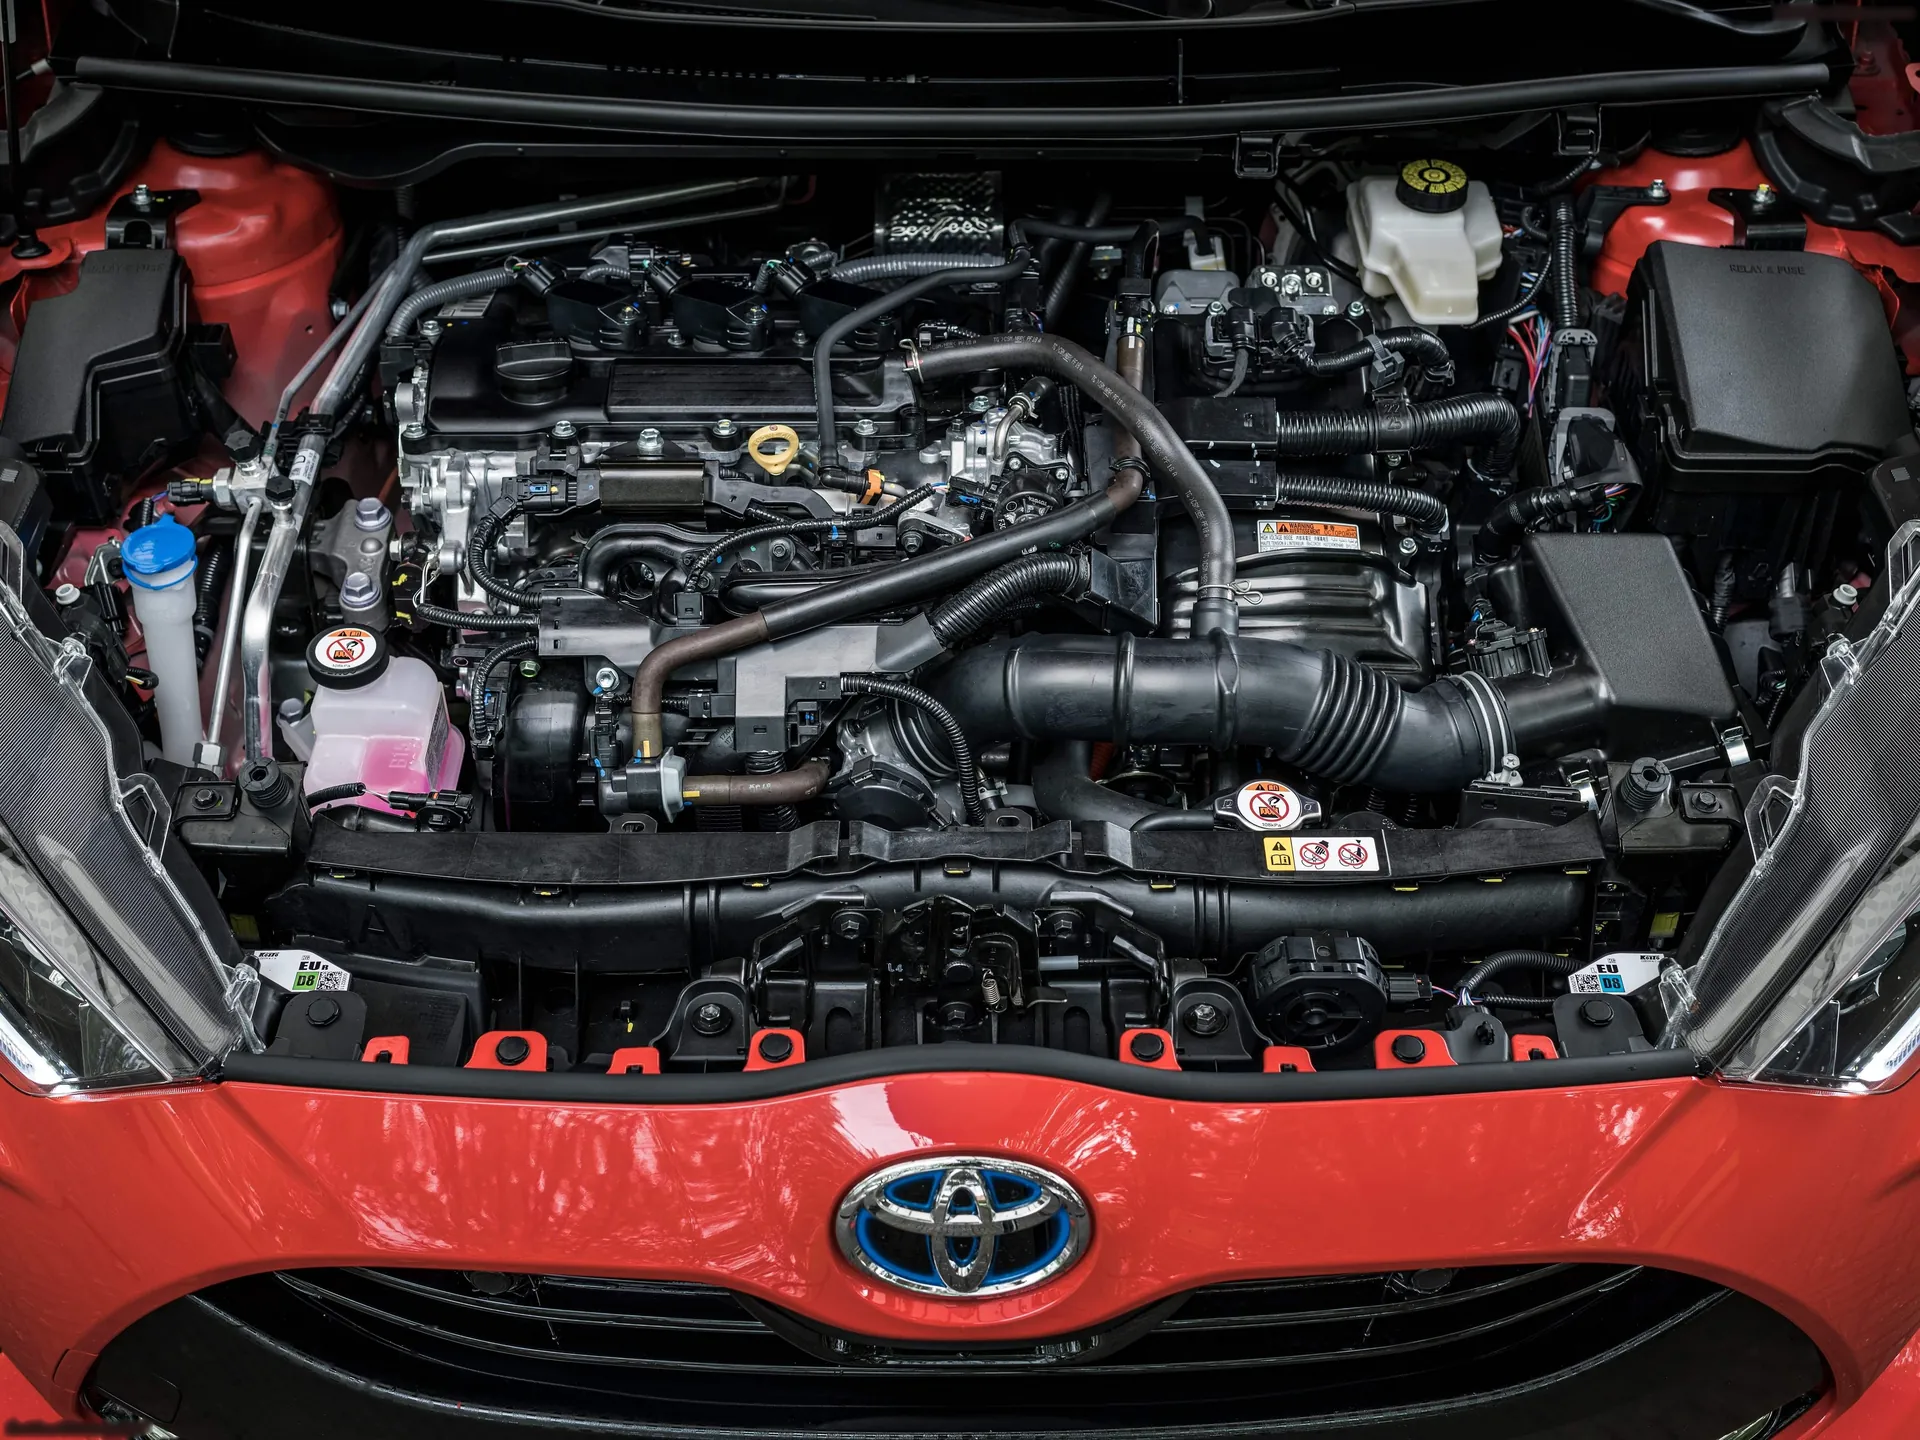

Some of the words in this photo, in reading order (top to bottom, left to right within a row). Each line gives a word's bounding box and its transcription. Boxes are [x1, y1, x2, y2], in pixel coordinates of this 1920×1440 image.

[1729, 263, 1764, 274] RELAY
[1777, 265, 1806, 276] FUSE
[298, 961, 322, 971] EU
[1596, 964, 1619, 974] EU
[296, 975, 316, 986] D8
[1602, 977, 1621, 989] D8
